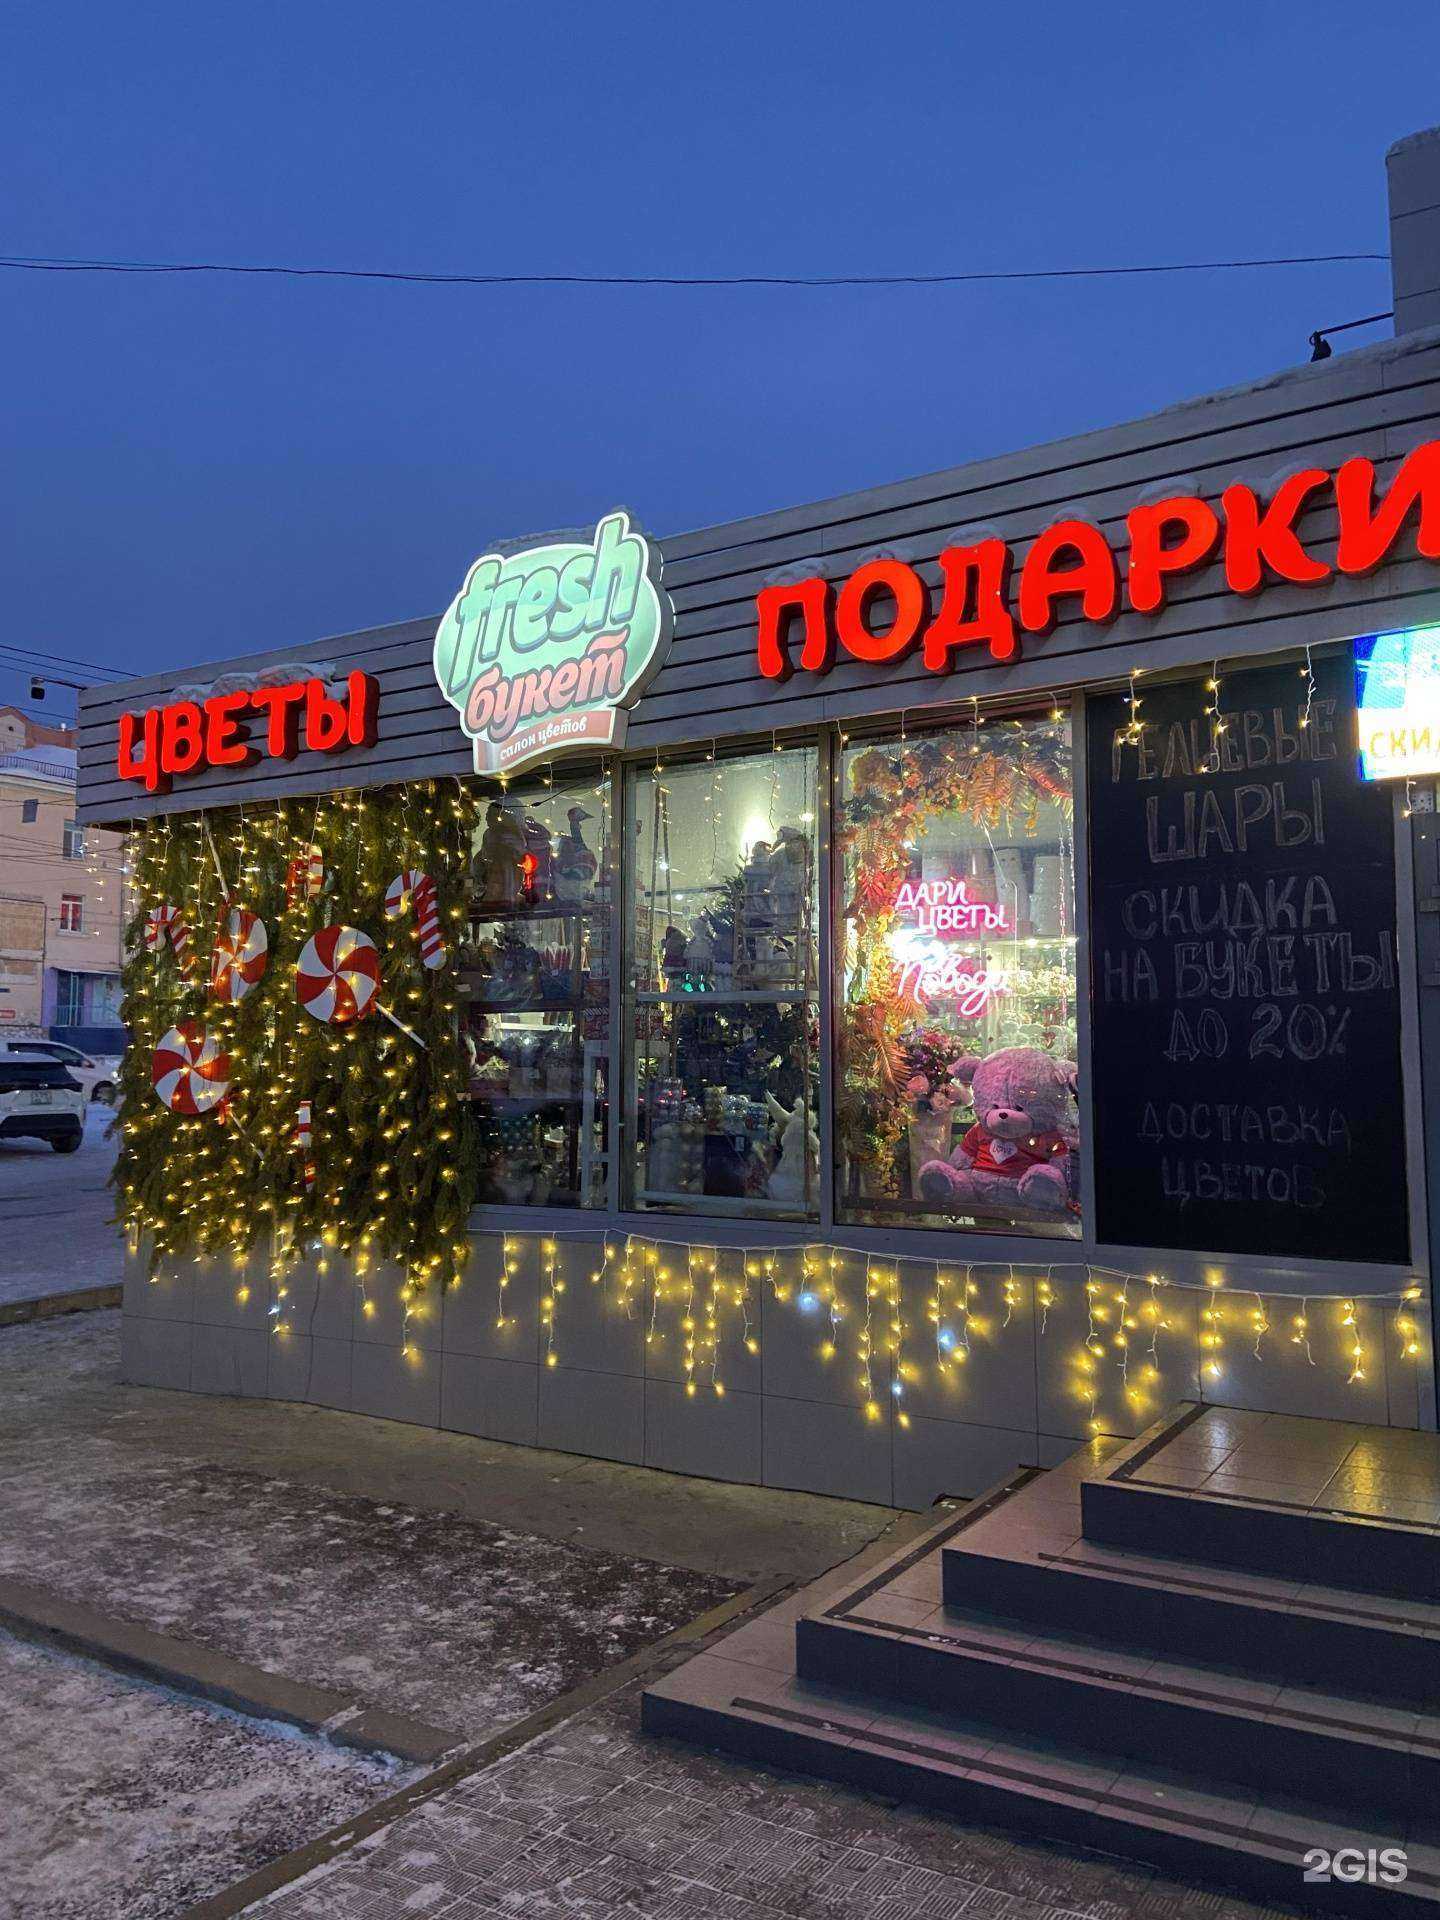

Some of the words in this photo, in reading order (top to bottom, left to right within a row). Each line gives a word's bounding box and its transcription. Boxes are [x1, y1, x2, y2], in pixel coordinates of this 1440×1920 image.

[757, 440, 1440, 679] ПОДАРКИ
[449, 516, 644, 697] fresh
[465, 626, 631, 743] букет
[118, 669, 376, 793] ЦВЕТЫ
[500, 734, 536, 760] салон
[538, 716, 588, 744] цветов
[1370, 726, 1440, 759] СКИ
[1146, 776, 1326, 863] ШАРЫ
[894, 880, 969, 912] ДАРИ
[917, 903, 1010, 937] ЦВЕТЫ
[1121, 874, 1338, 941] СКИДКА
[1103, 948, 1159, 1001] НА
[1174, 929, 1395, 999] БУКЕТЫ
[1162, 1007, 1228, 1062] ДО
[1249, 1003, 1352, 1062] 20%
[1137, 1101, 1351, 1147] ДОСТАВКА
